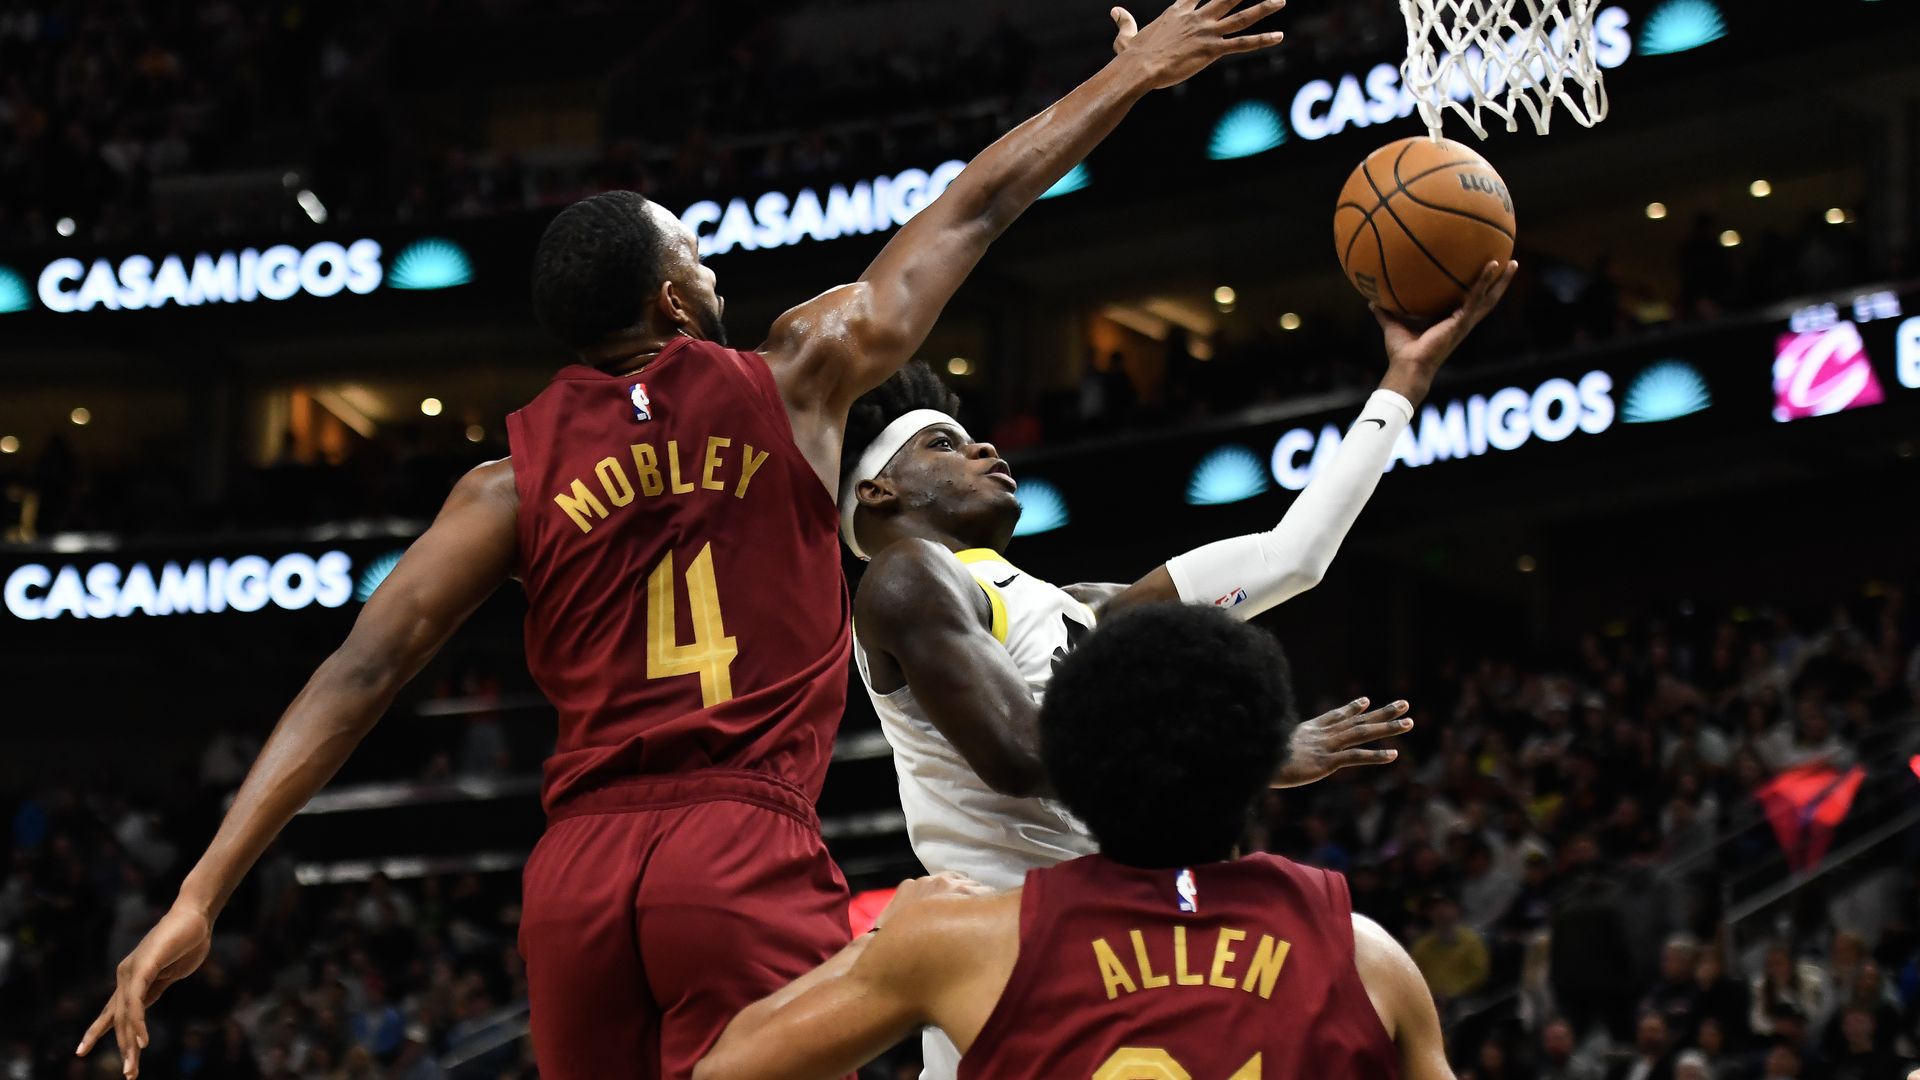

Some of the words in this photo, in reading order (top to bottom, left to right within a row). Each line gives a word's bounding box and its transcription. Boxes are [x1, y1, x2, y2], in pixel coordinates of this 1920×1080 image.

[38, 238, 382, 312] CASAMIGOS
[1271, 370, 1615, 490] CAAMIGOS
[554, 436, 769, 533] MOBLEY
[4, 550, 353, 620] CASAMIGOS
[647, 541, 738, 709] 4
[1092, 926, 1291, 1000] ALLEN
